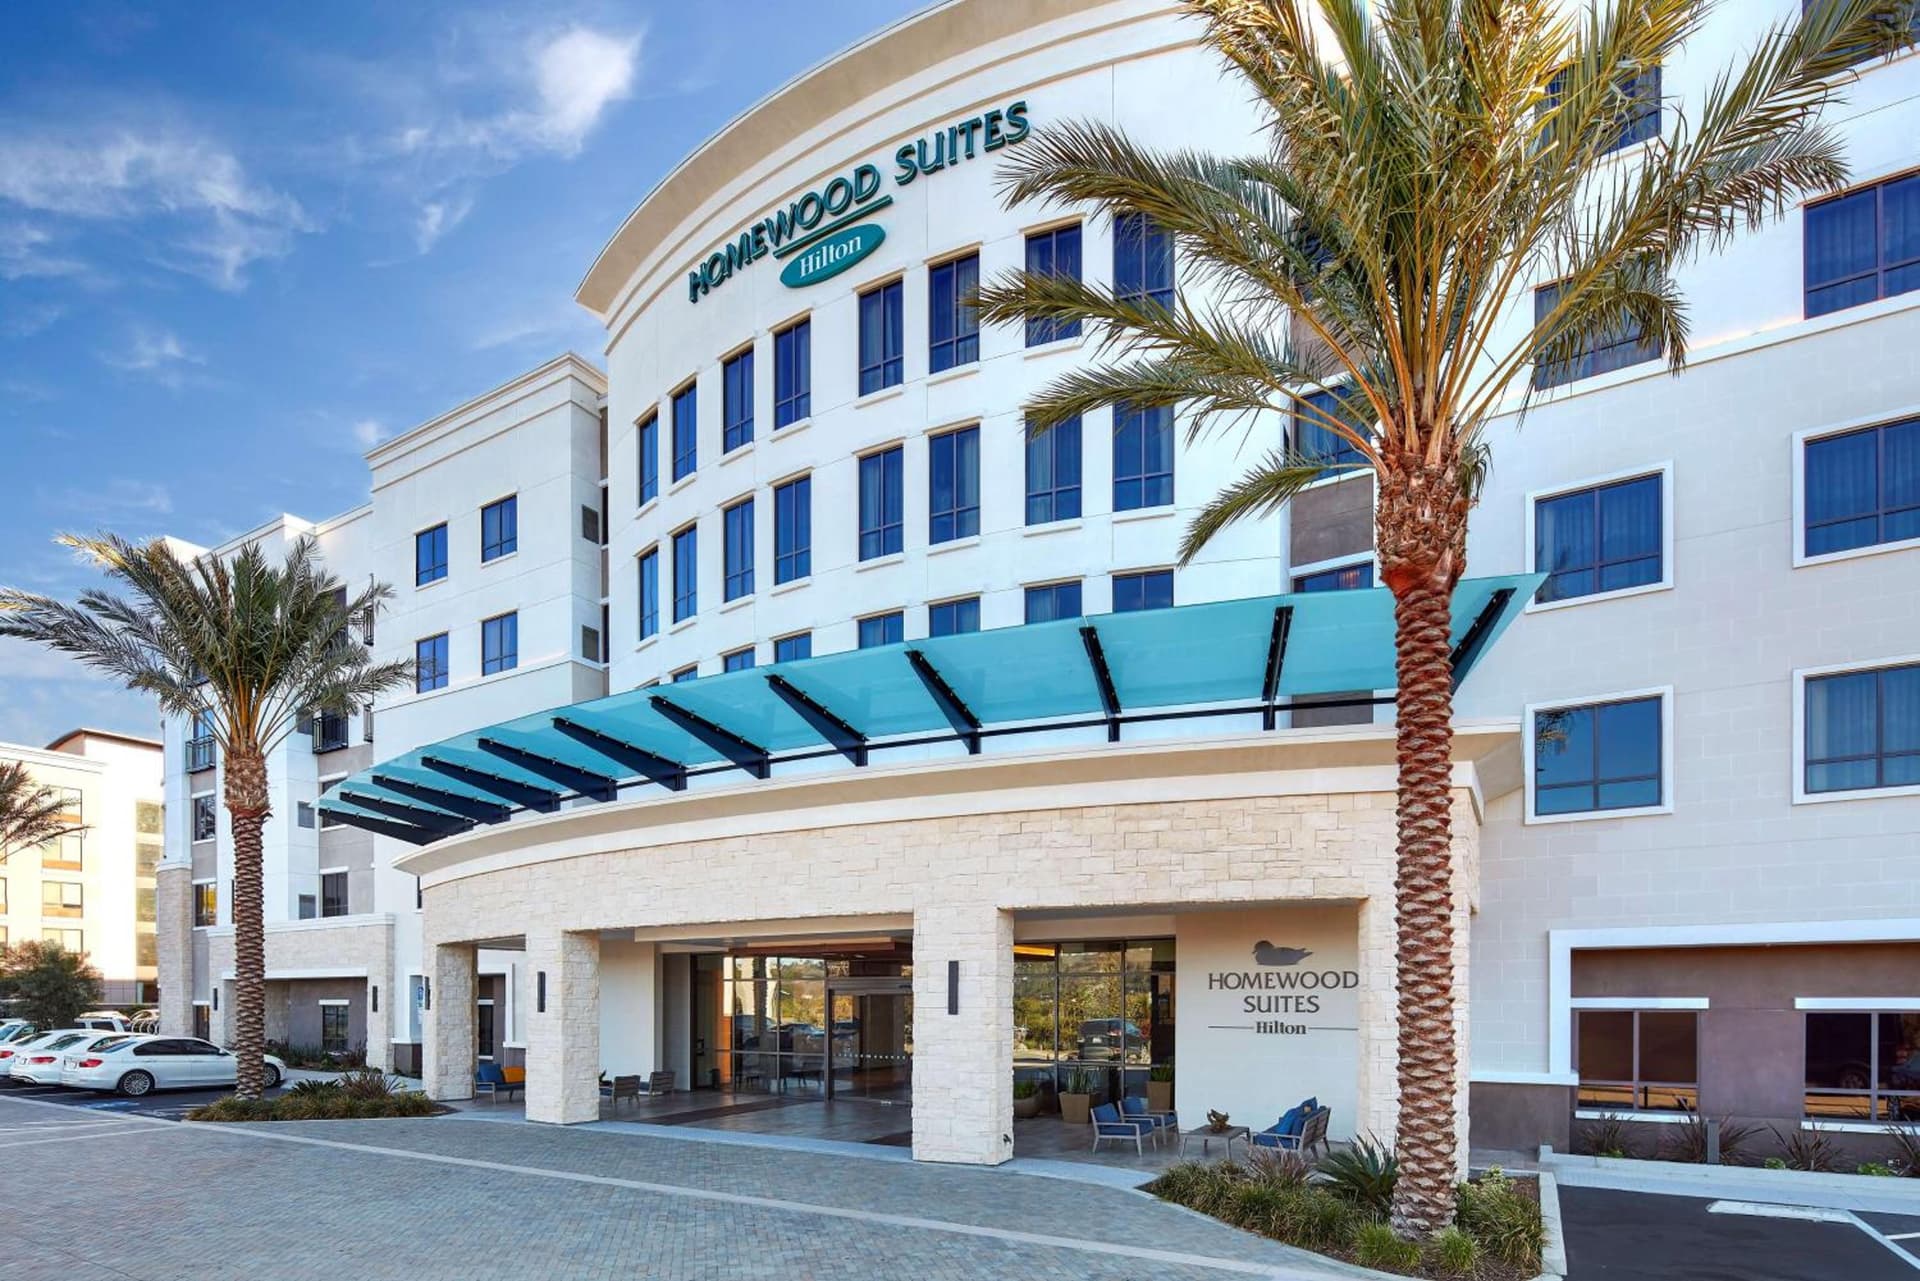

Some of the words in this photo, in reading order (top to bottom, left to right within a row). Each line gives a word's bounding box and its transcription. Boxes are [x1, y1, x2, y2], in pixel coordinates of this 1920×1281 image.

[688, 163, 882, 304] HOMEWOOD
[894, 100, 1031, 186] SUITES
[799, 235, 862, 278] Hilton
[1208, 970, 1359, 990] HOMEWOOD
[1243, 994, 1320, 1014] SUITES
[1255, 1020, 1307, 1035] Hilton
